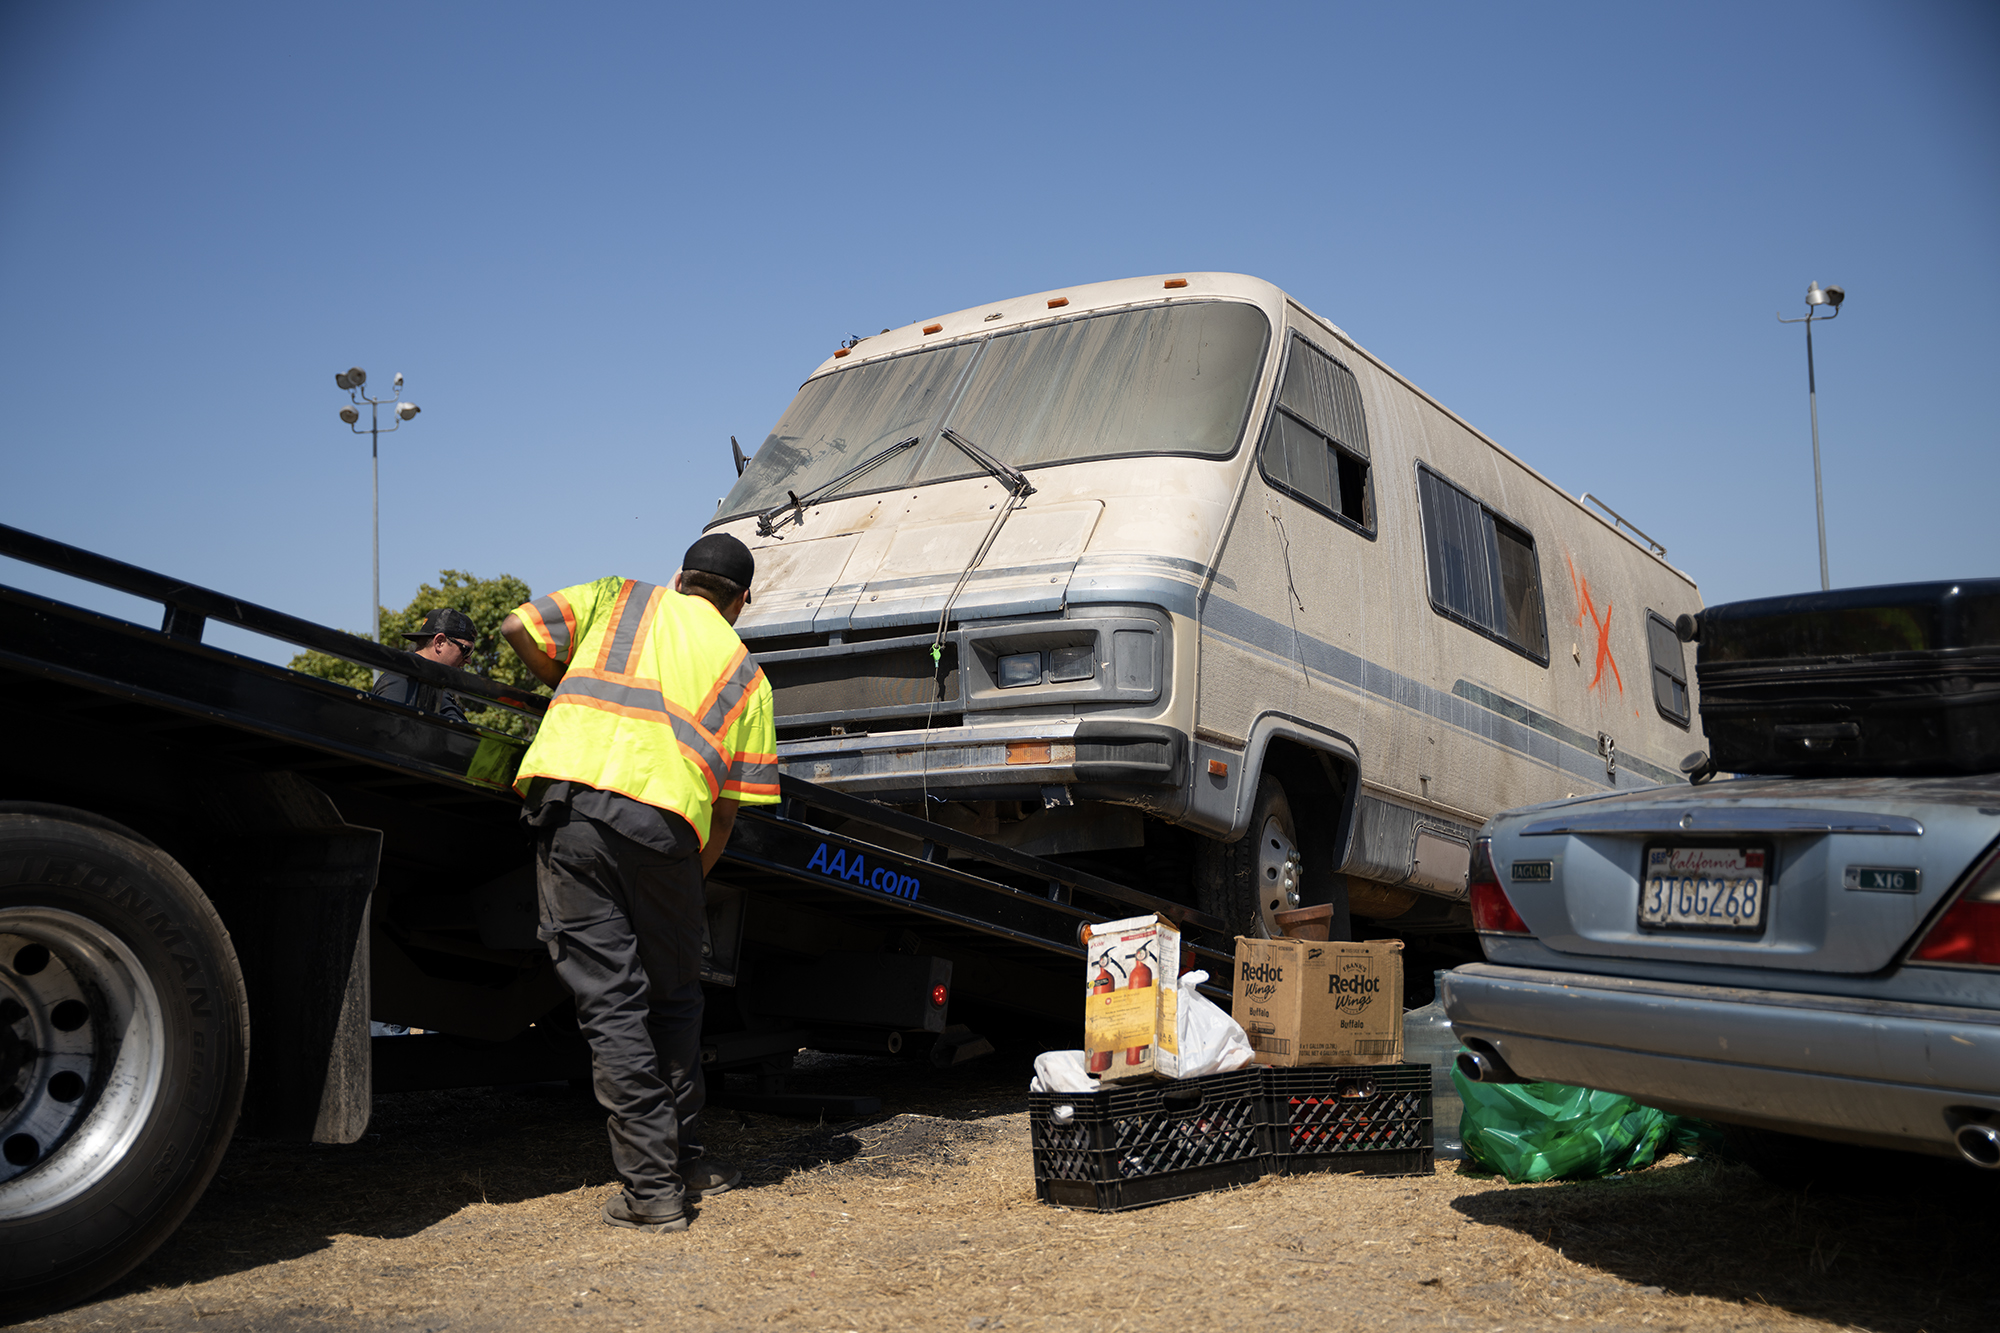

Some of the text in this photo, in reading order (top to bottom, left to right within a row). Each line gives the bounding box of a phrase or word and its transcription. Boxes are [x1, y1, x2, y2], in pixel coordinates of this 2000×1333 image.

[1669, 850, 1745, 872] California
[806, 842, 920, 900] AAA.com
[1513, 864, 1549, 878] JAGUAR
[1873, 872, 1905, 889] XJ6
[1649, 876, 1757, 918] 3TGG268
[1241, 962, 1283, 982] RedHot
[1245, 982, 1277, 999] Wings
[1328, 974, 1380, 994] RedHot
[1335, 994, 1373, 1010] Wings
[1249, 1007, 1269, 1018] Buffalo
[1340, 1019, 1364, 1029] Buffalo
